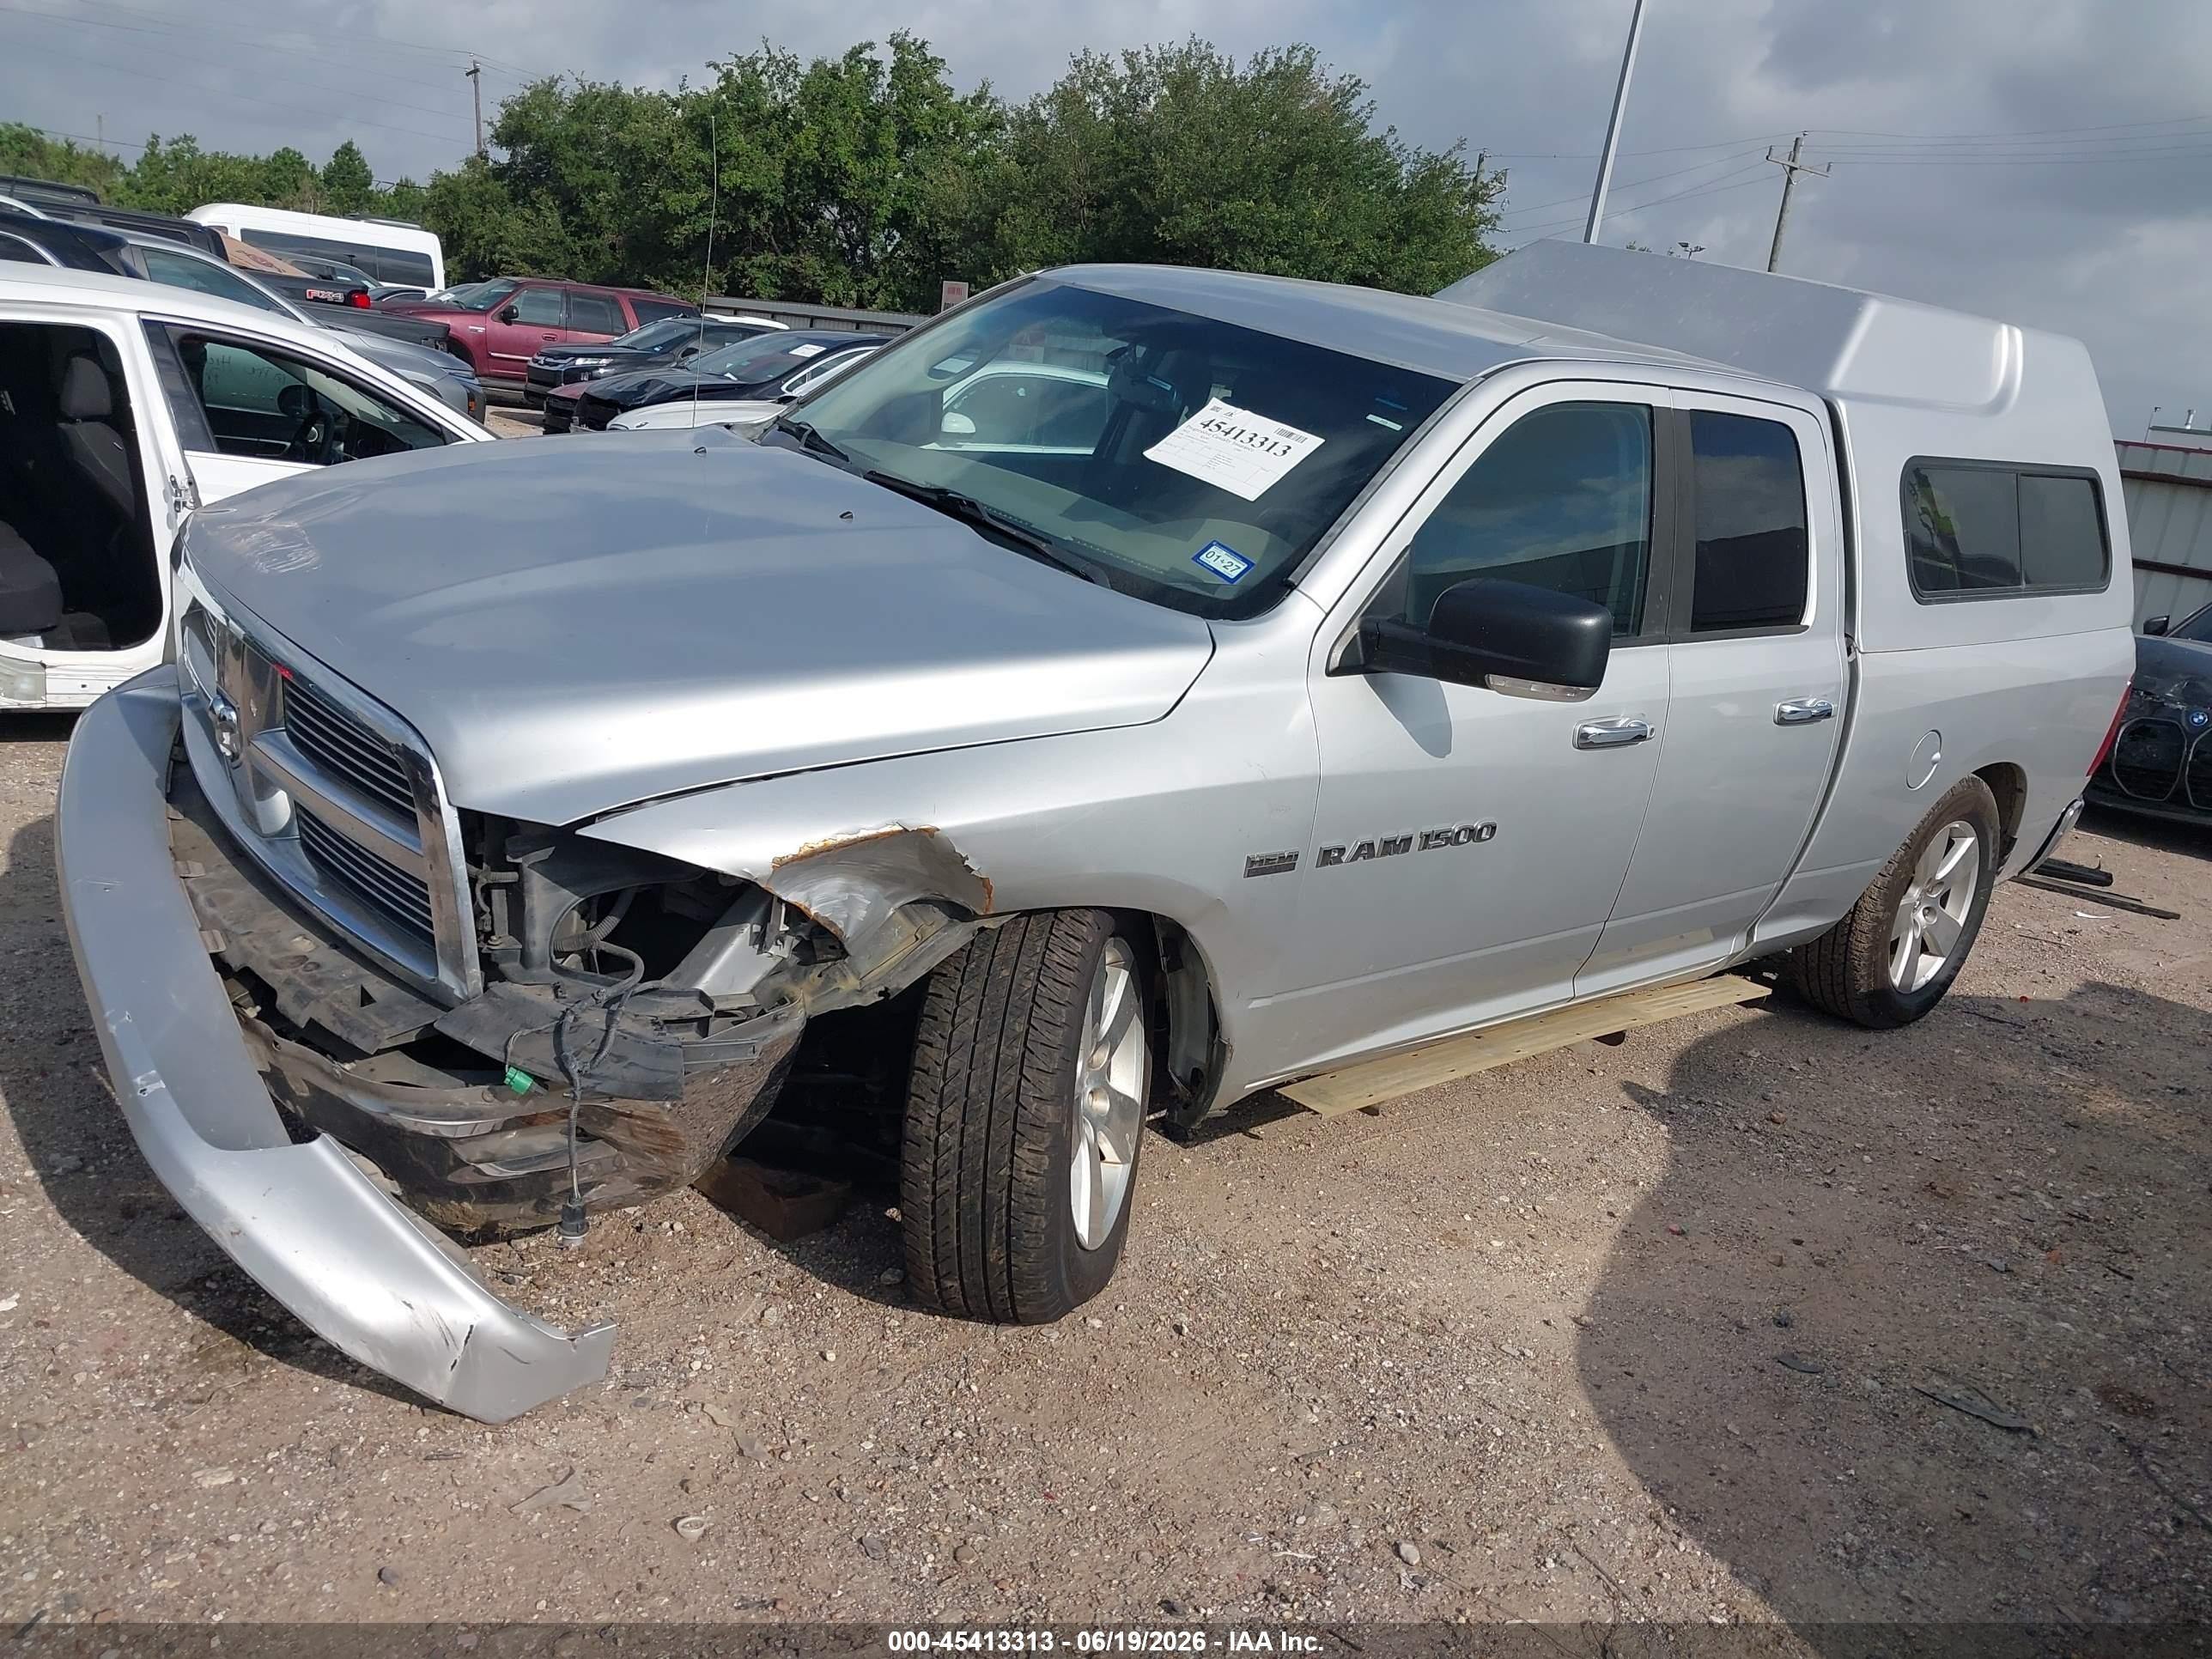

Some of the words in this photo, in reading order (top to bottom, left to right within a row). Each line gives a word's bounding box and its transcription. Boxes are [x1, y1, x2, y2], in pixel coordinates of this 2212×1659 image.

[306, 289, 344, 301] FX4
[1200, 418, 1291, 457] 45413313
[1316, 833, 1413, 868] RAM
[1417, 820, 1498, 852] 1500
